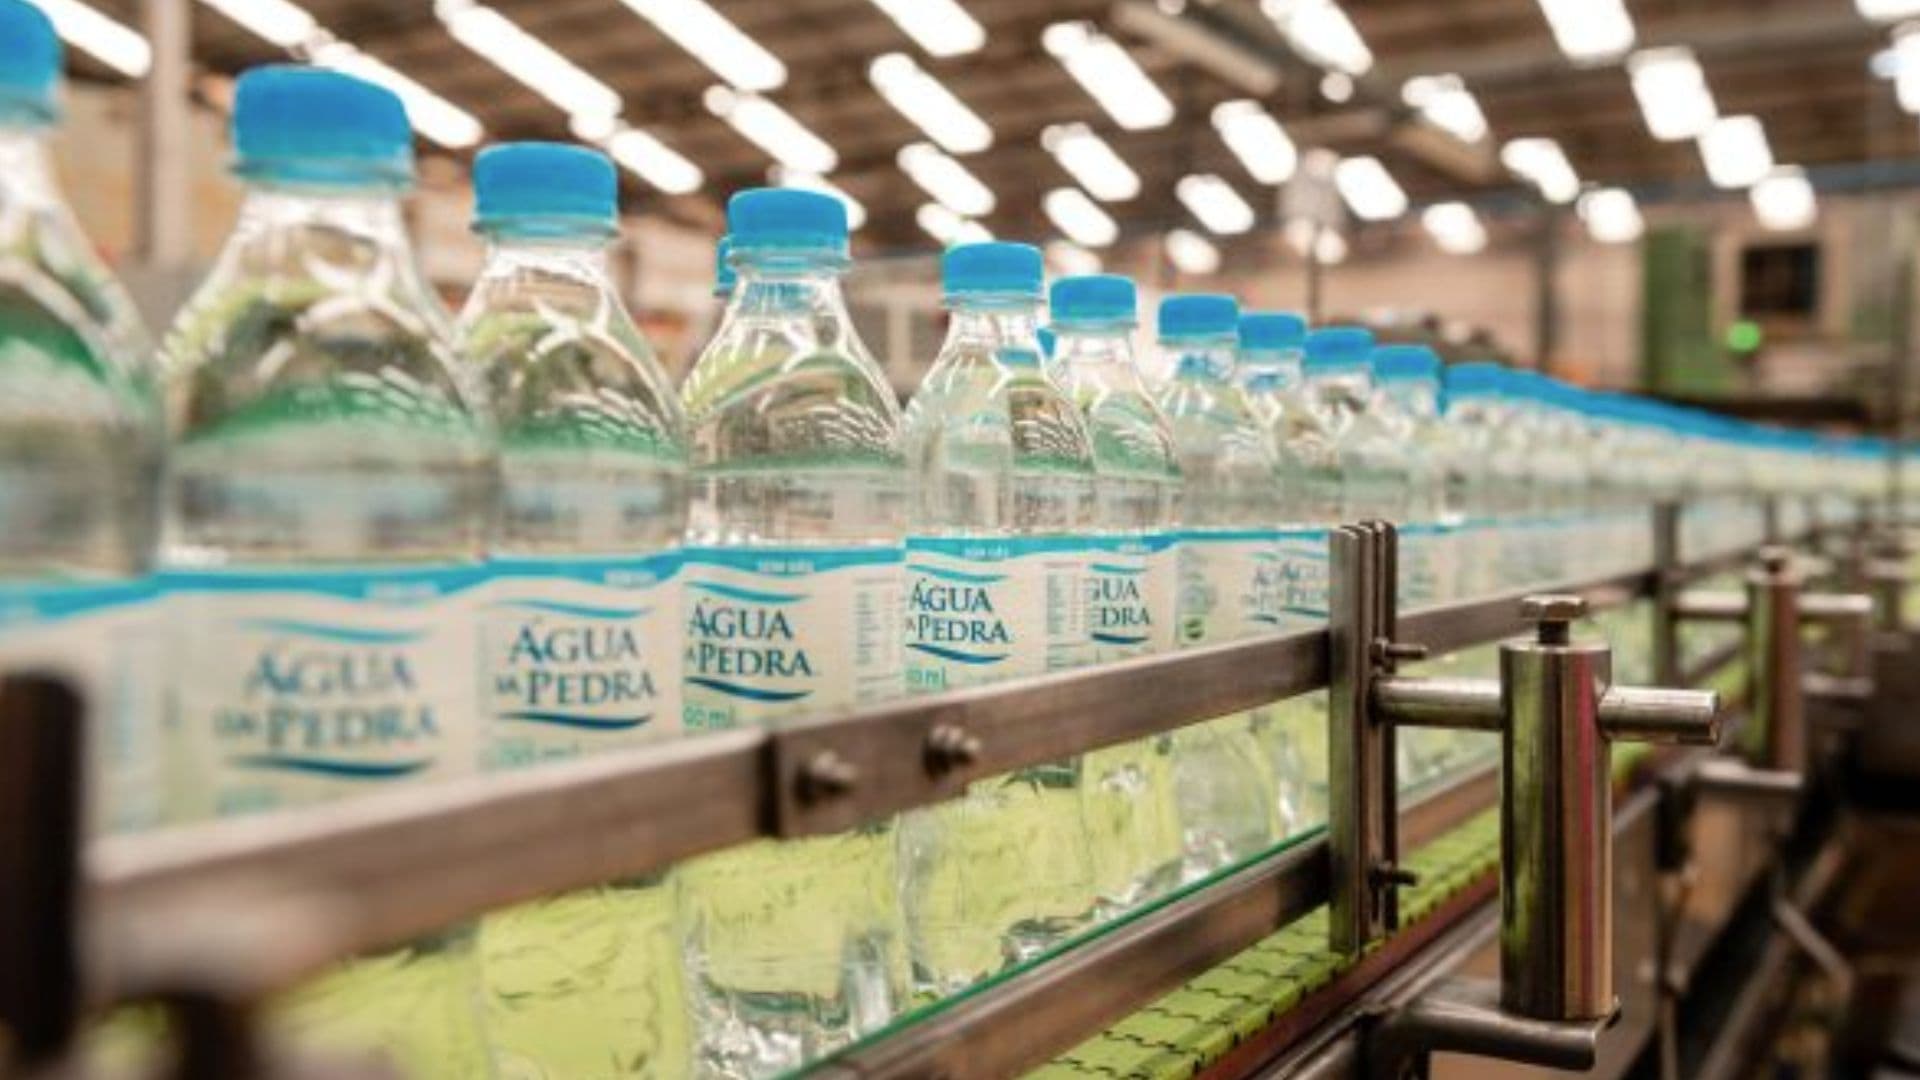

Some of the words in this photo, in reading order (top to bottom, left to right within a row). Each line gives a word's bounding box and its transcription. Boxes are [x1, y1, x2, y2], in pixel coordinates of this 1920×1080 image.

[1083, 577, 1141, 600] GUA
[918, 613, 1009, 643] PEDRA
[1088, 606, 1151, 627] EDRA
[699, 642, 813, 677] PEDRA
[526, 668, 657, 704] PEDRA
[264, 702, 438, 748] PEDRA
